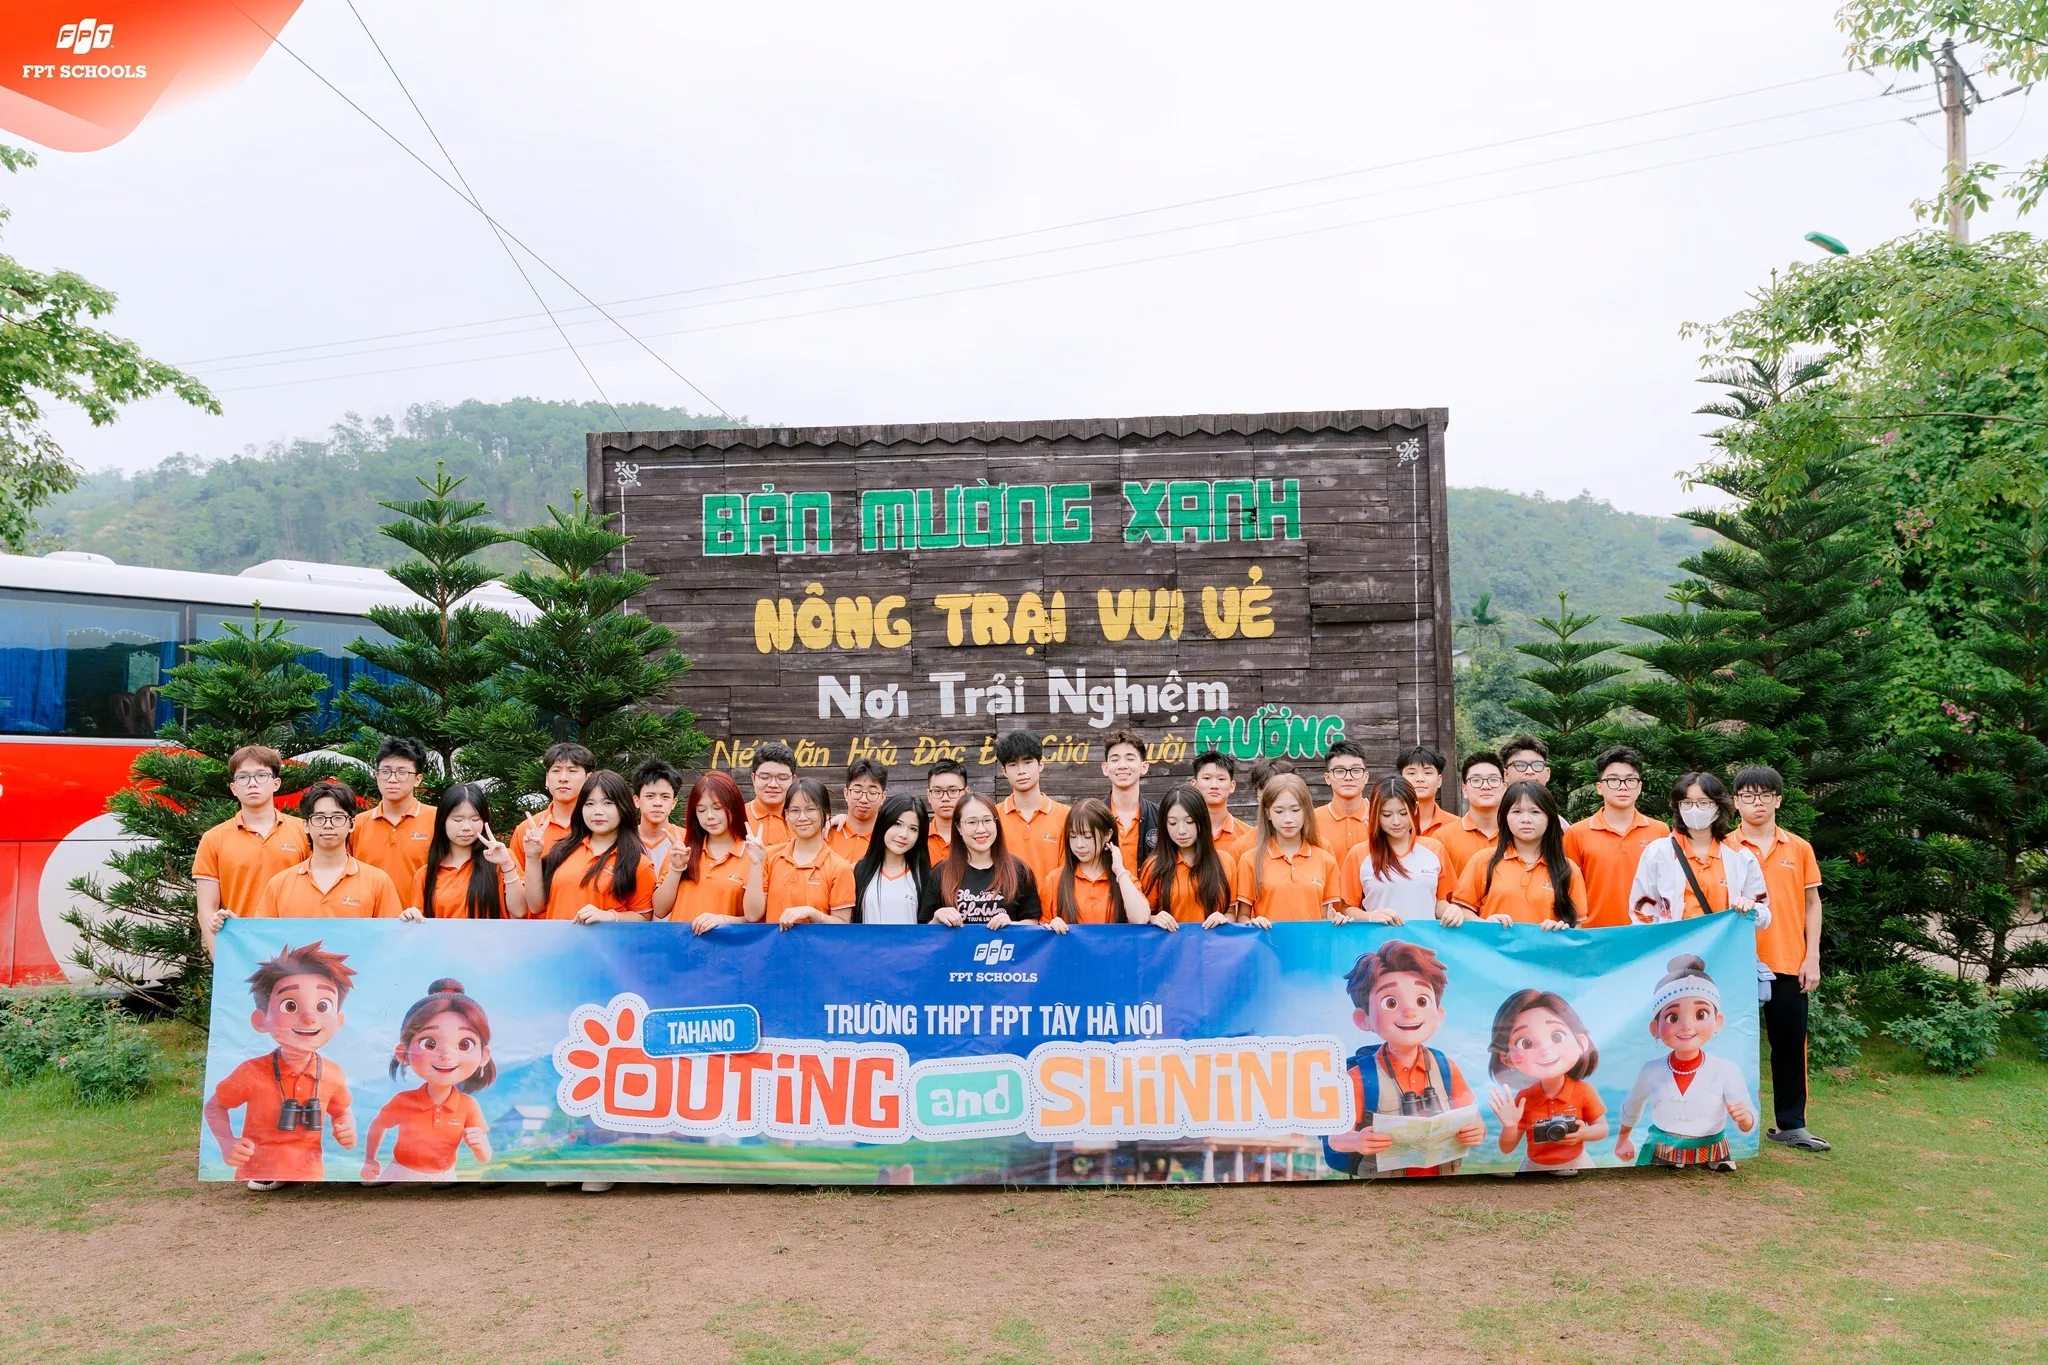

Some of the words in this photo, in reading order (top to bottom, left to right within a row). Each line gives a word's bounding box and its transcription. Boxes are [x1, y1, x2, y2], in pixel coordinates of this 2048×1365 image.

[702, 484, 832, 556] BẢN
[861, 478, 1092, 551] MƯỜNG
[1123, 478, 1302, 543] XANH
[754, 582, 911, 653] NÔNG
[934, 592, 1067, 655] TRẠI
[1097, 586, 1185, 641] VUI
[1202, 565, 1275, 638] VẺ
[818, 675, 910, 720] Nơi
[929, 672, 1025, 717] Trải
[1048, 668, 1229, 729] Nghiệm
[711, 739, 768, 769] Né
[1193, 703, 1346, 761] MƯỜNG
[949, 972, 973, 983] FPT
[976, 972, 1038, 983] SCHOOLS
[667, 1018, 736, 1045] TAHANO
[824, 1000, 918, 1035] TRƯỜNG
[924, 1005, 983, 1035] THPT
[990, 1005, 1032, 1035] FPT
[1039, 1002, 1081, 1036] TÂY
[1087, 1002, 1119, 1036] HÀ
[1124, 1001, 1163, 1039] NỘI
[930, 1074, 1010, 1118] and
